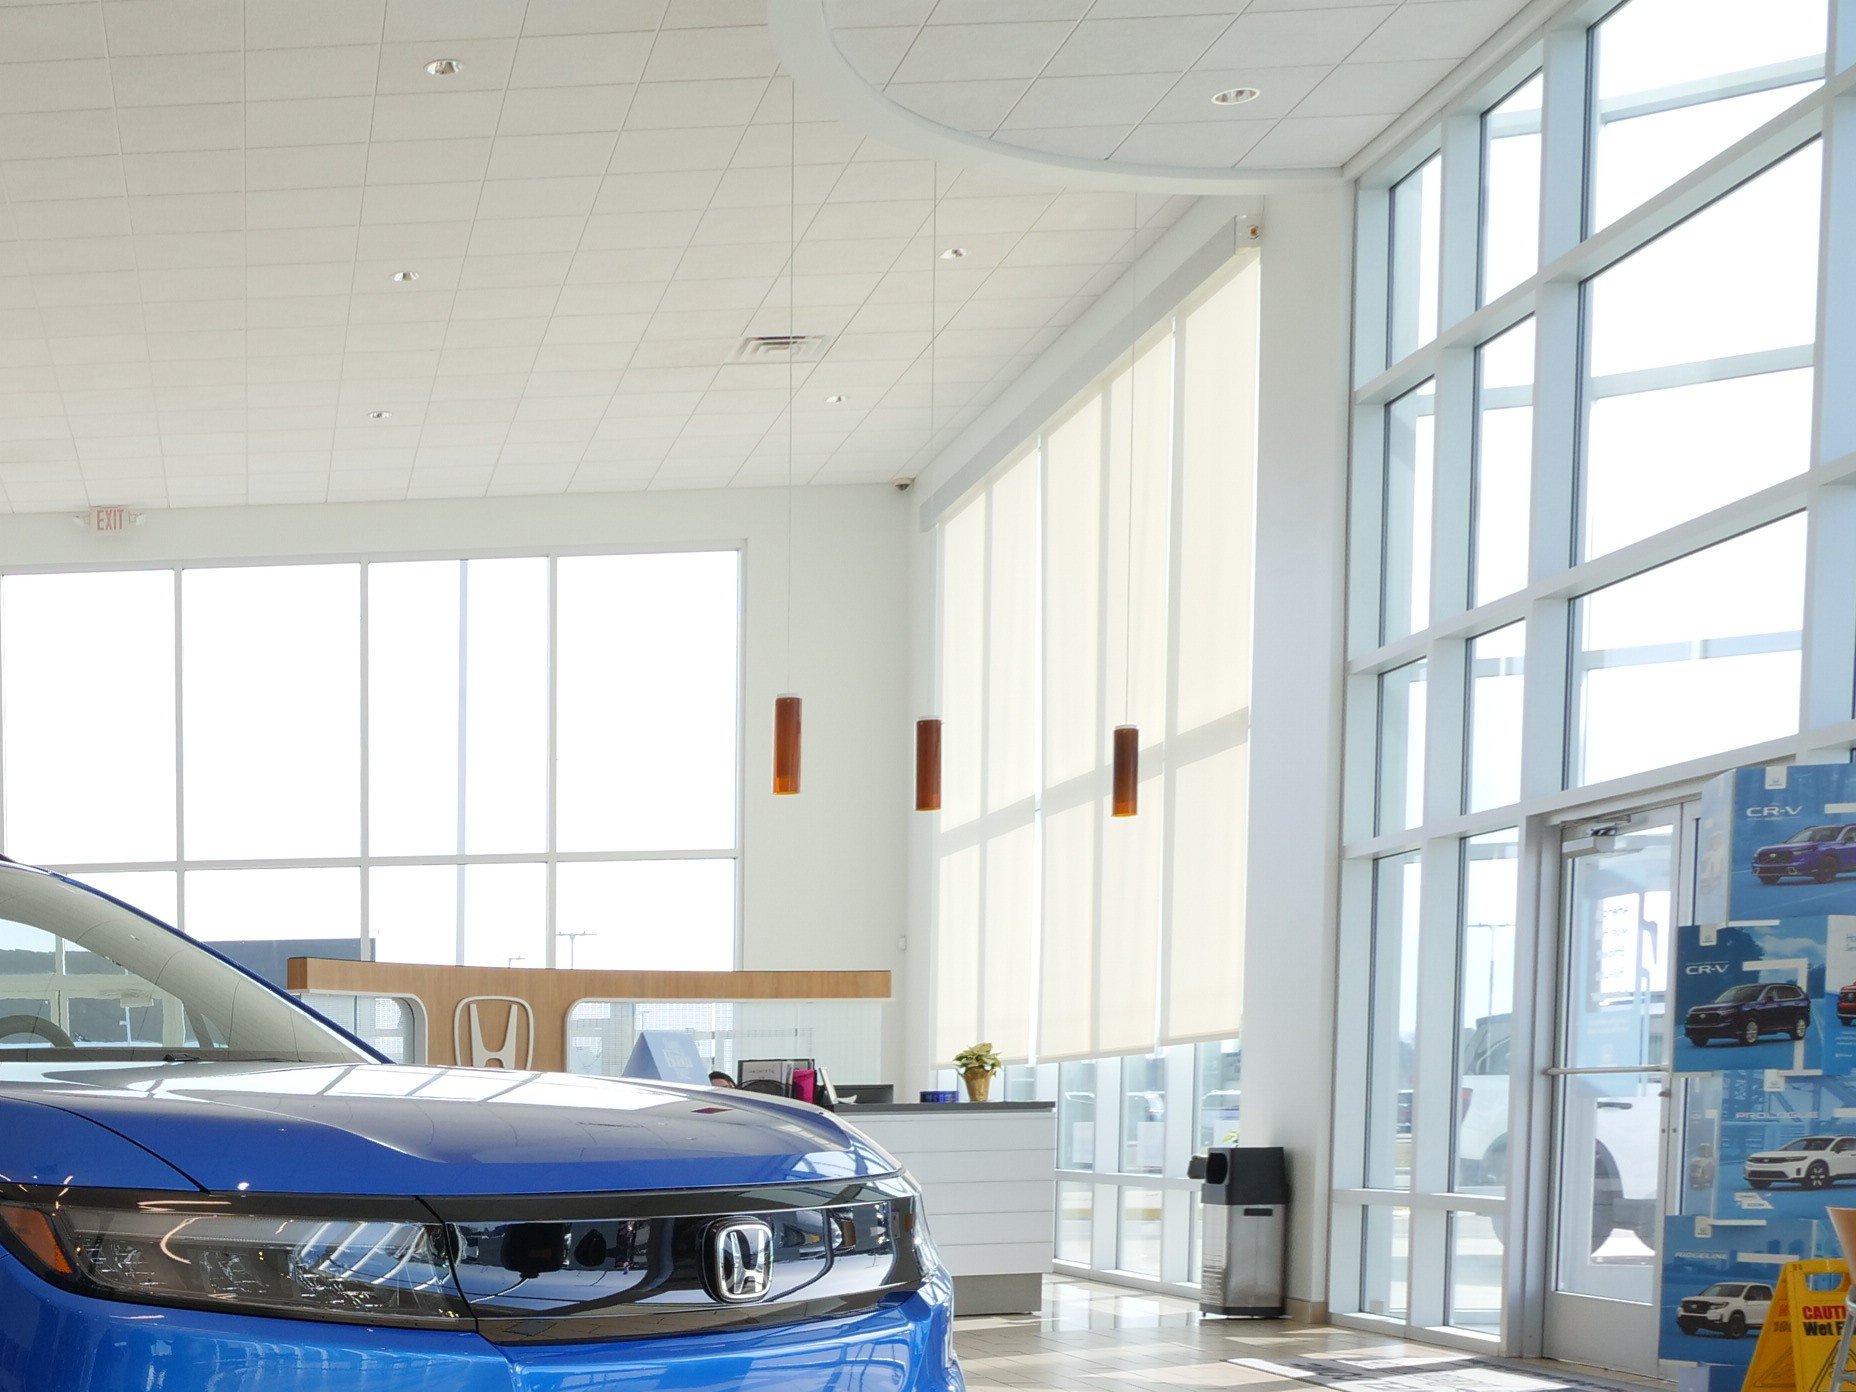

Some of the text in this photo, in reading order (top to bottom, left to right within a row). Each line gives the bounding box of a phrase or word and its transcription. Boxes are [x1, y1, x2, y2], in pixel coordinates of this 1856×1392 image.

[96, 509, 124, 531] EXIT
[1746, 805, 1803, 817] CR-V
[1685, 964, 1730, 975] CR-V
[1674, 1251, 1728, 1260] RIDGELINE
[1803, 1321, 1834, 1336] Wet
